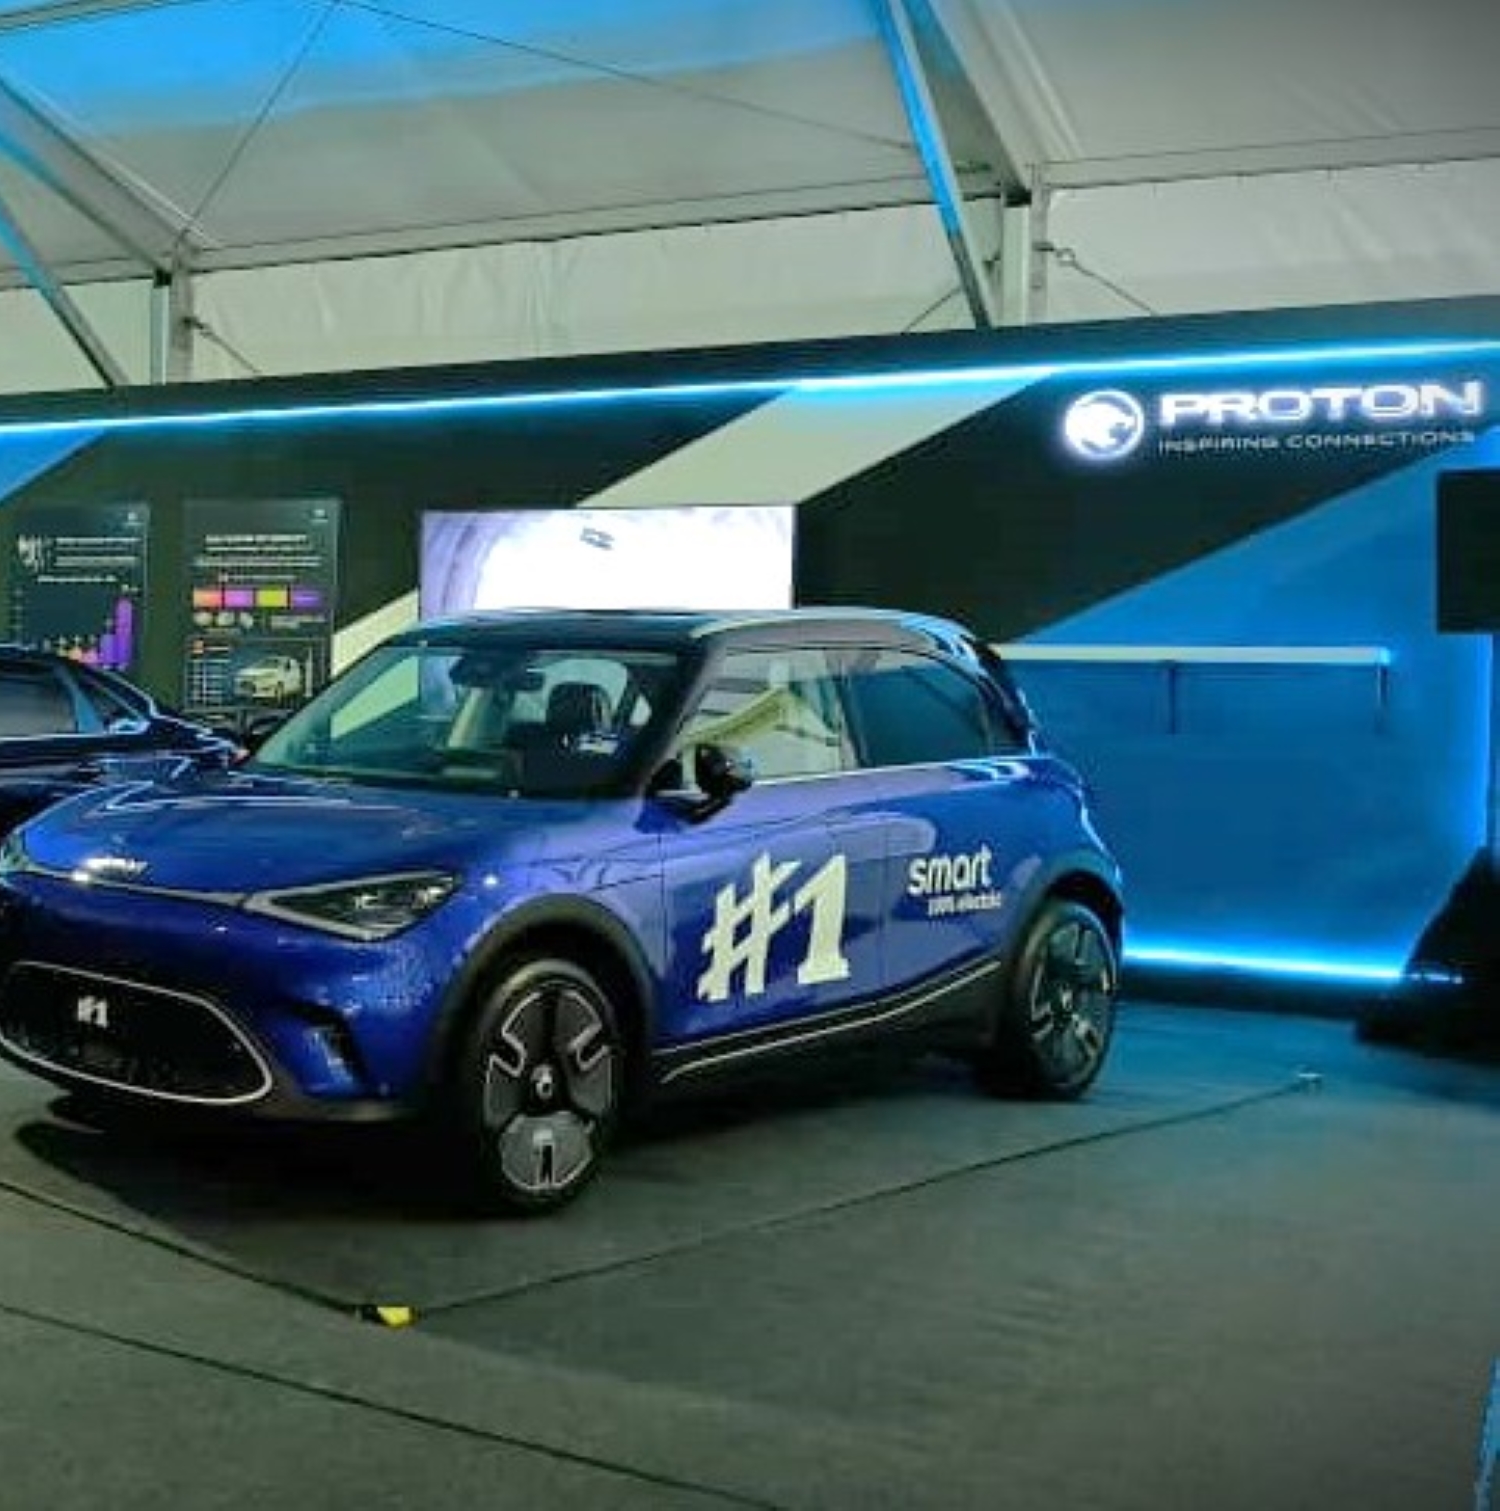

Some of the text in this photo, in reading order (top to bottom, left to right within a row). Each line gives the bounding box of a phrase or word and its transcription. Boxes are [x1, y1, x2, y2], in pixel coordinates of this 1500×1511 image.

[1160, 382, 1483, 426] PROTON
[1159, 430, 1475, 453] INSPIRING CONNECTIONS
[907, 843, 992, 895] smart
[698, 852, 850, 1003] #1
